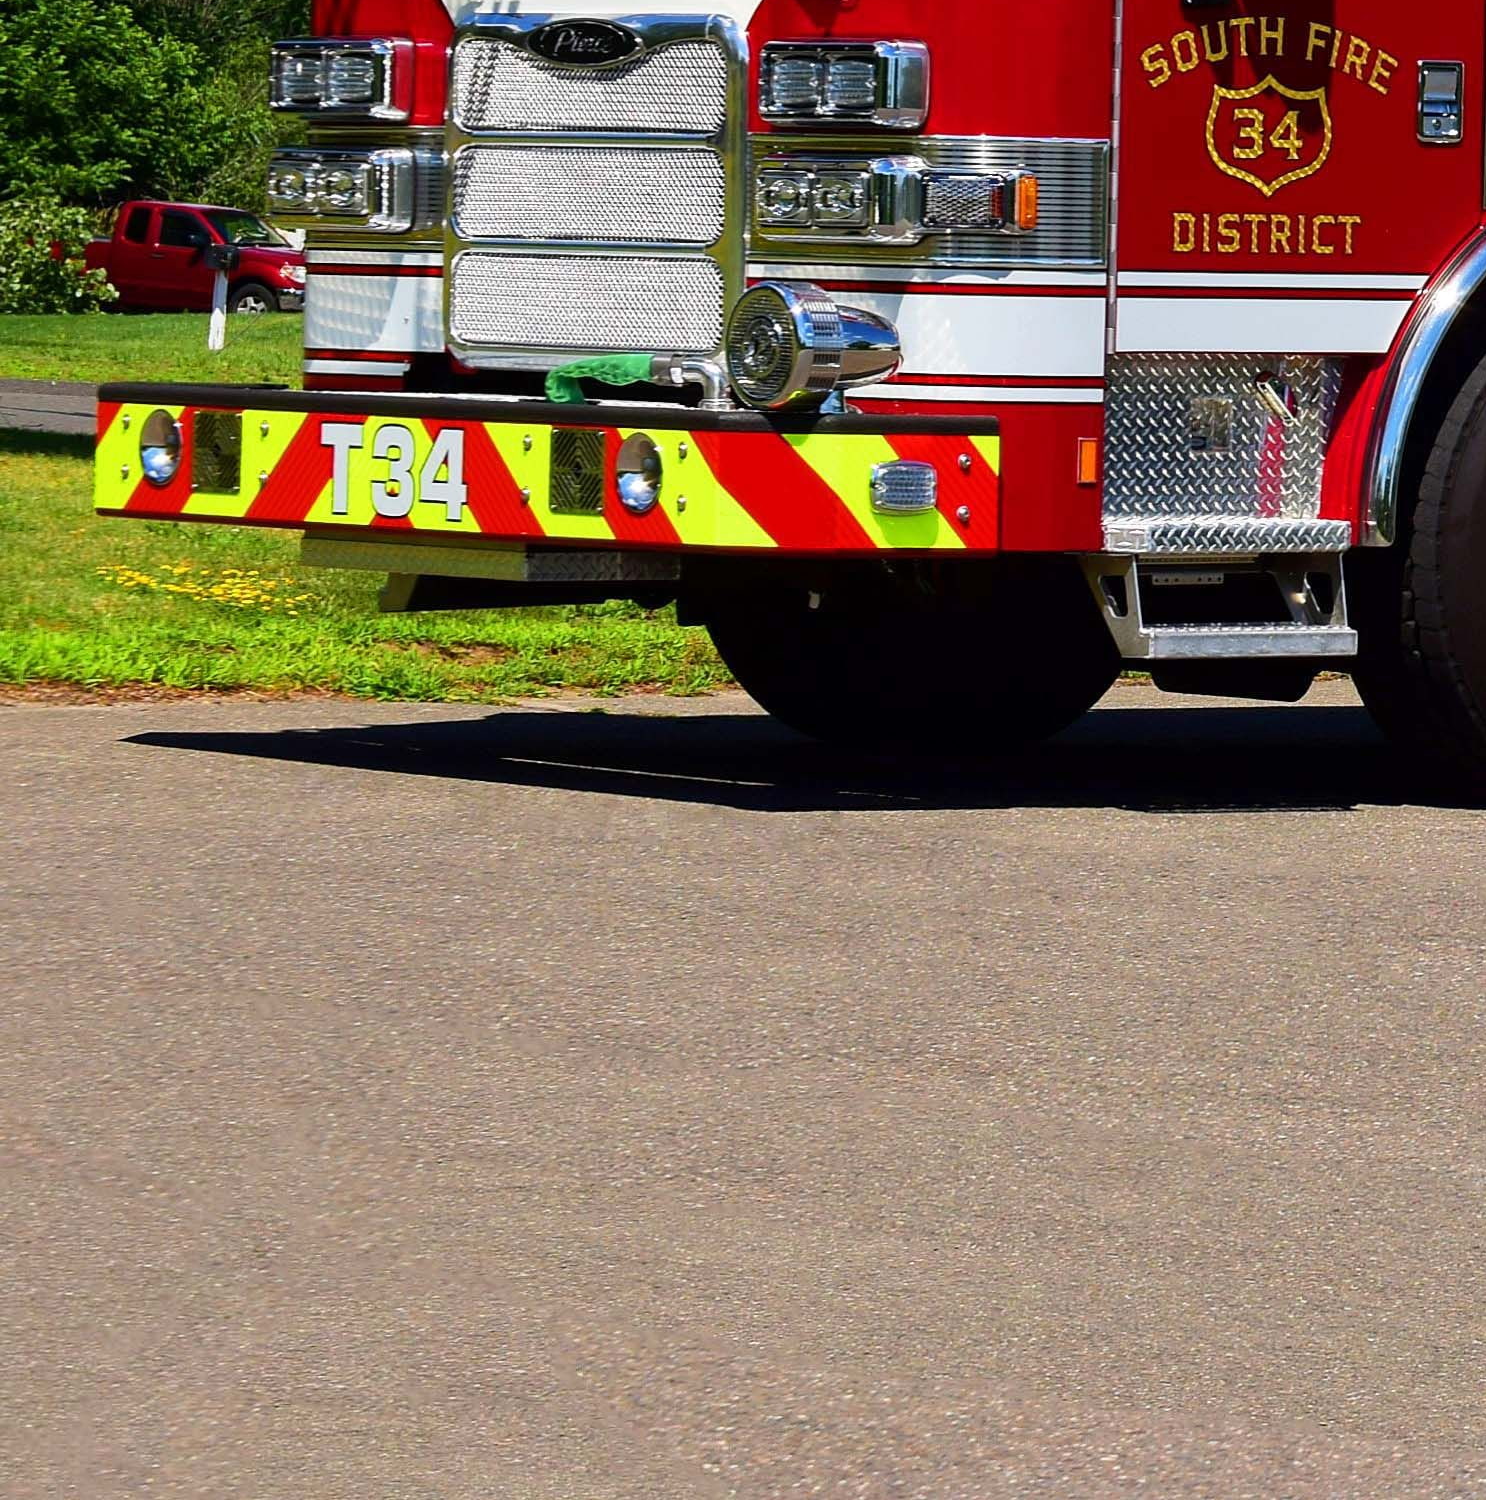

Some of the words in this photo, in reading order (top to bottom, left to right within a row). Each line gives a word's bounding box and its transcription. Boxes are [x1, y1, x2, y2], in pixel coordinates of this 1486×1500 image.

[1140, 16, 1286, 88] SOUTH
[1305, 21, 1399, 95] FIRE
[1232, 107, 1304, 160] 34
[1172, 212, 1362, 254] DISTRICT
[319, 422, 468, 522] T34
